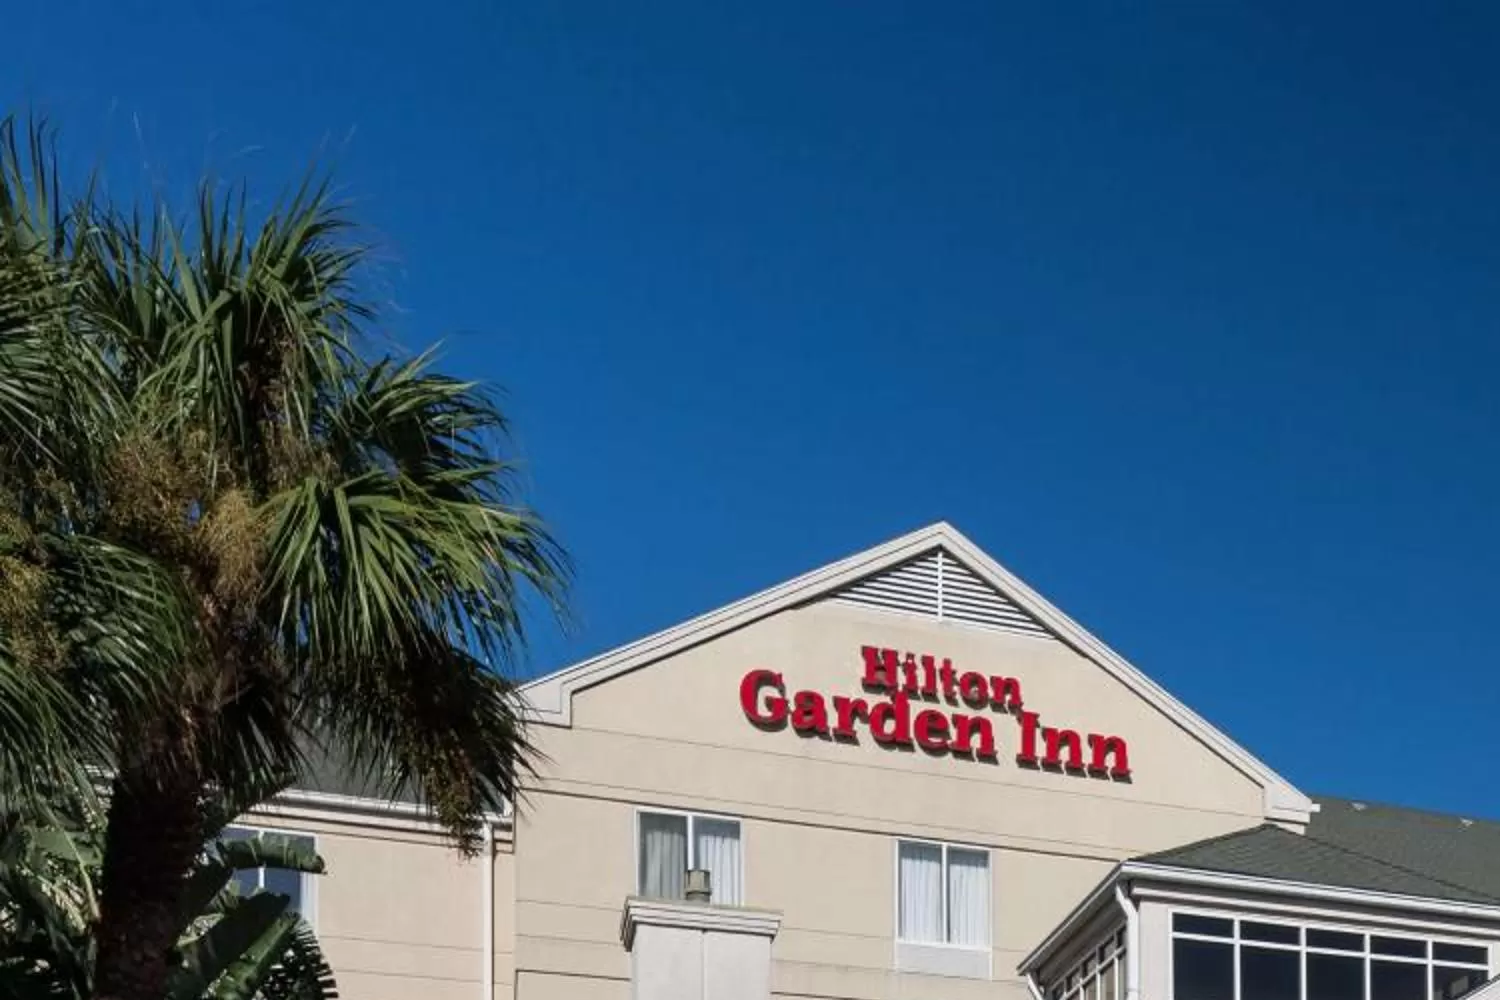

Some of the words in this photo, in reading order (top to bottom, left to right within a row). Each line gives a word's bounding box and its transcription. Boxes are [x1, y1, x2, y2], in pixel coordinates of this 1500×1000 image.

[861, 645, 1022, 710] Hilton
[739, 669, 998, 759] Garden
[1015, 710, 1132, 780] Inn
